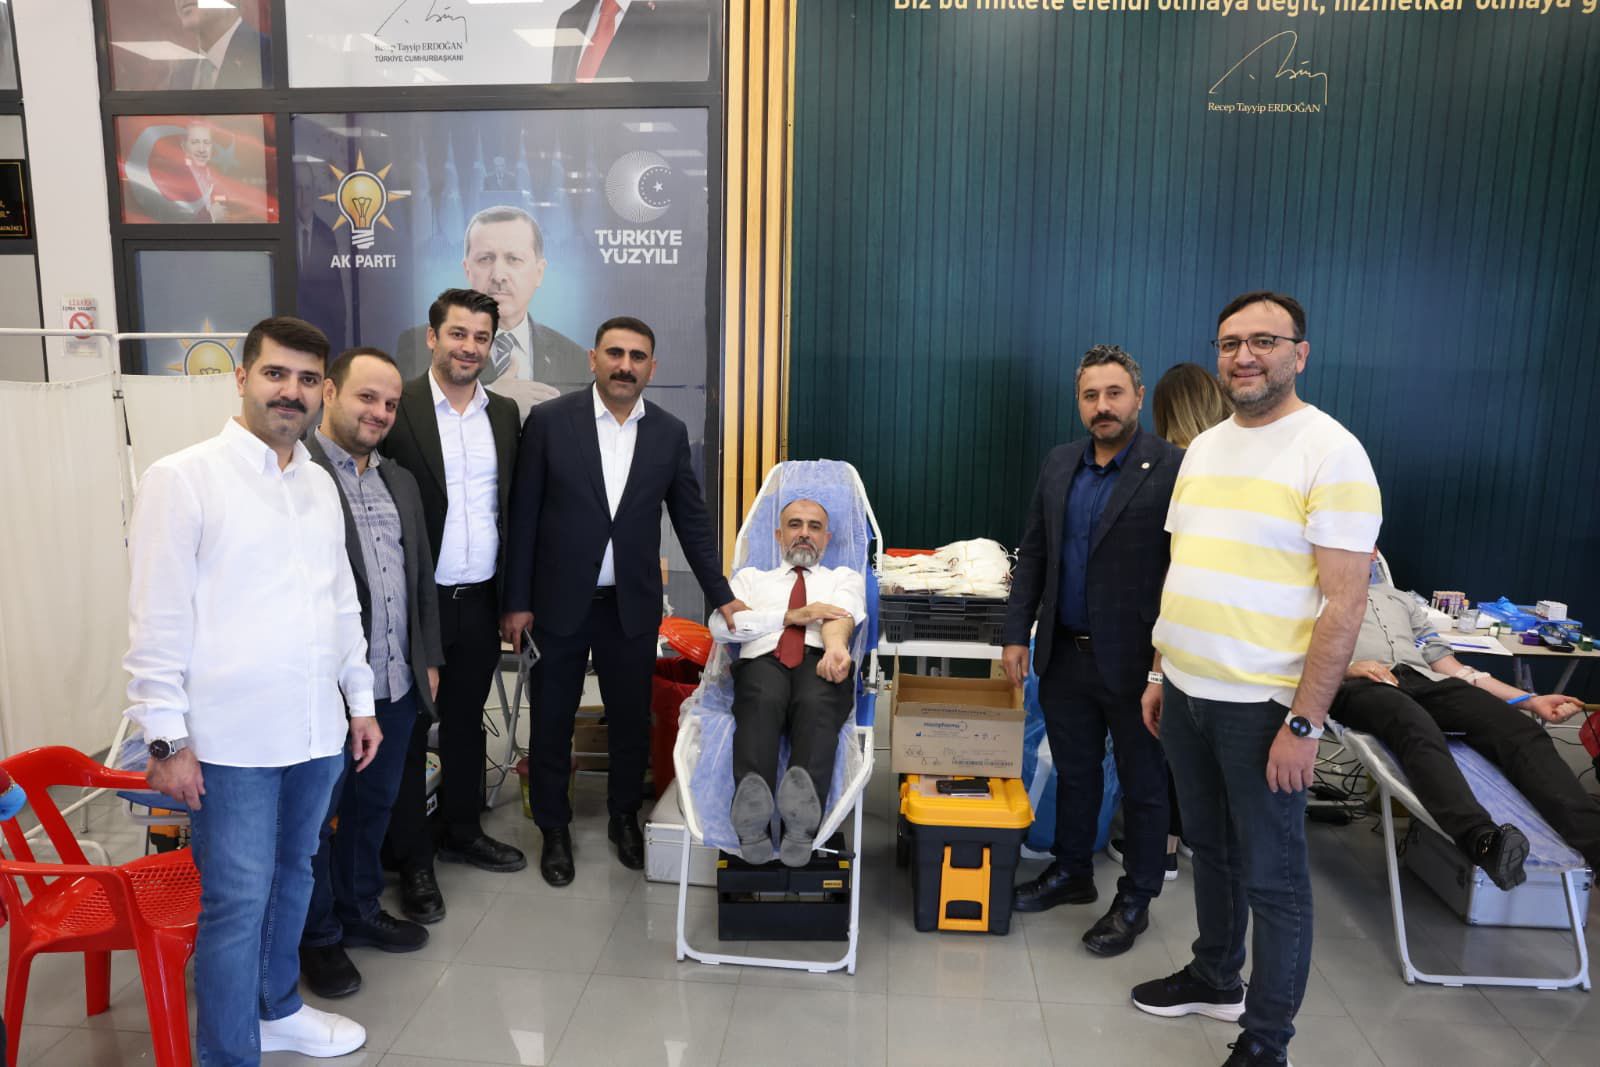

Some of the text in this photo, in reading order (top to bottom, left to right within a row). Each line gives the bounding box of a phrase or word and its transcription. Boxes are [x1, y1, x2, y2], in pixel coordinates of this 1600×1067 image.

[422, 40, 463, 51] ERDOĞAN
[1208, 102, 1321, 114] Recep Tayyip ERDOĞAN
[330, 254, 352, 268] AK
